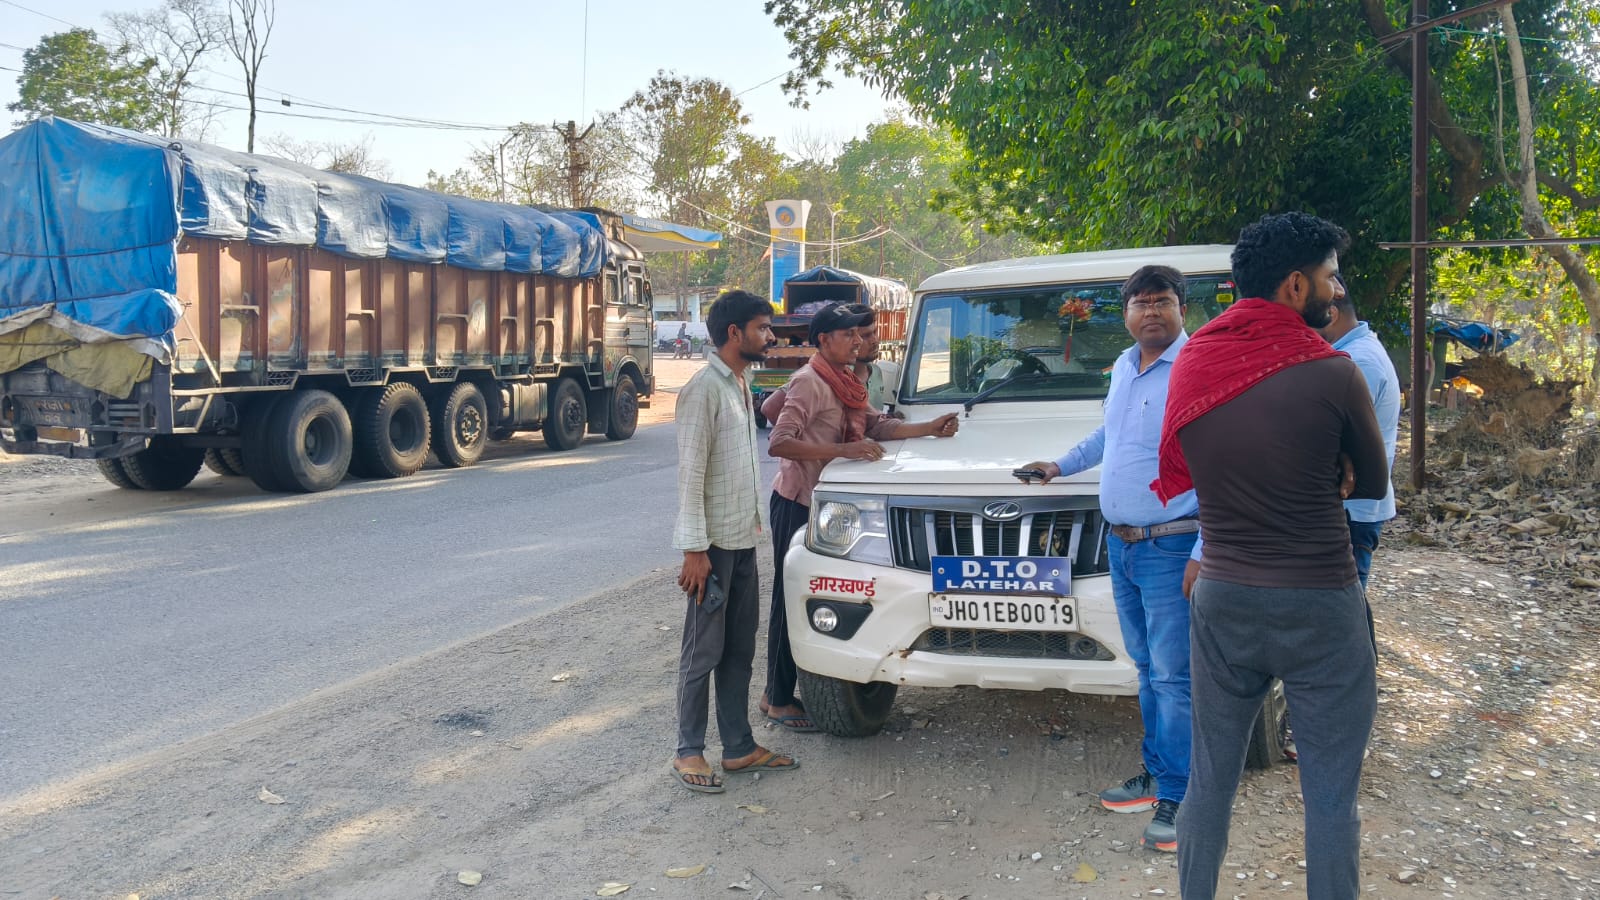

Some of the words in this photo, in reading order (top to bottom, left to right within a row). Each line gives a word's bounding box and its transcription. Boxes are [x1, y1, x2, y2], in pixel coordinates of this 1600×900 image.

[961, 560, 1038, 579] D.T.O
[946, 579, 1055, 592] LATEHAR
[943, 600, 1074, 625] JH01EB0019
